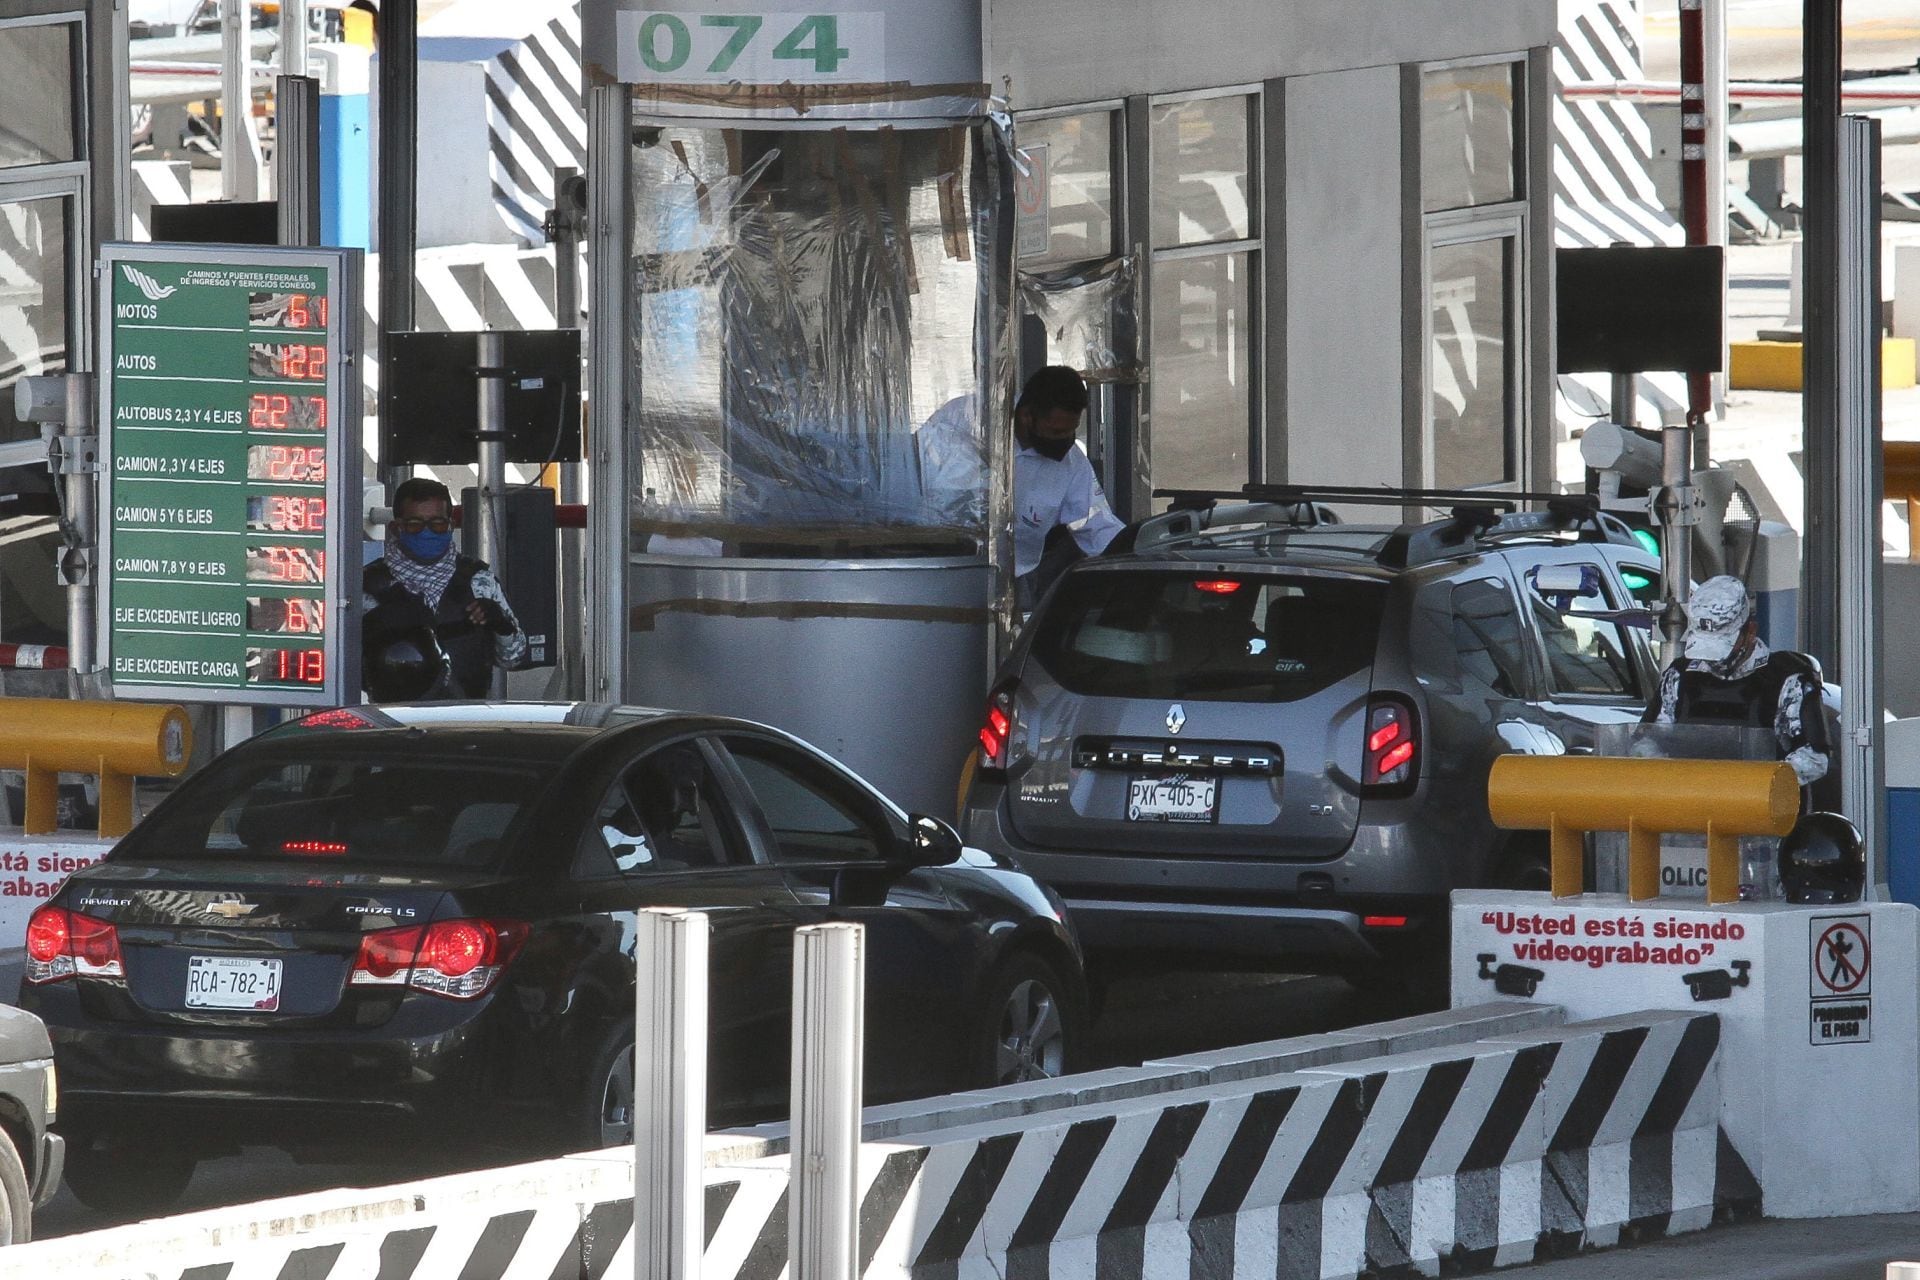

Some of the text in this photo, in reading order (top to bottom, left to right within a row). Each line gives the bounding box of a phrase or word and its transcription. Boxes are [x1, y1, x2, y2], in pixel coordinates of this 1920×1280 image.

[638, 13, 849, 72] 074
[180, 277, 316, 290] DE INGRESOS Y SERVICIOS CONEXOS
[187, 270, 222, 279] CAMINOS
[229, 272, 264, 280] PUENTES
[264, 273, 309, 282] FEDERALES
[117, 304, 157, 320] MOTOS
[117, 355, 156, 370] AUTOS
[283, 345, 326, 378] 122
[117, 406, 242, 424] AUTOBUS 2,3 Y 4 EJES
[116, 456, 158, 473] CAMION
[180, 458, 188, 473] Y
[189, 459, 196, 473] 4
[198, 459, 225, 474] EJES
[116, 506, 213, 524] CAMION 5 Y 6 EJES
[115, 558, 226, 576] CAMION 7,8 Y 9 EJES
[115, 607, 241, 627] EJE EXCEDENTE LIGERO
[115, 657, 239, 677] EJE EXCEDENTE CARGA
[280, 650, 323, 681] 113
[1130, 784, 1214, 808] PXK-405-C
[0, 851, 29, 872] tá
[0, 876, 66, 898] aba
[80, 897, 131, 906] CHEVROLET
[345, 906, 416, 917] CRUZE LS
[1584, 916, 1645, 937] está
[1653, 917, 1745, 940] siendo
[190, 969, 275, 995] RCA-782-A
[1821, 1021, 1860, 1038] EL PASO
